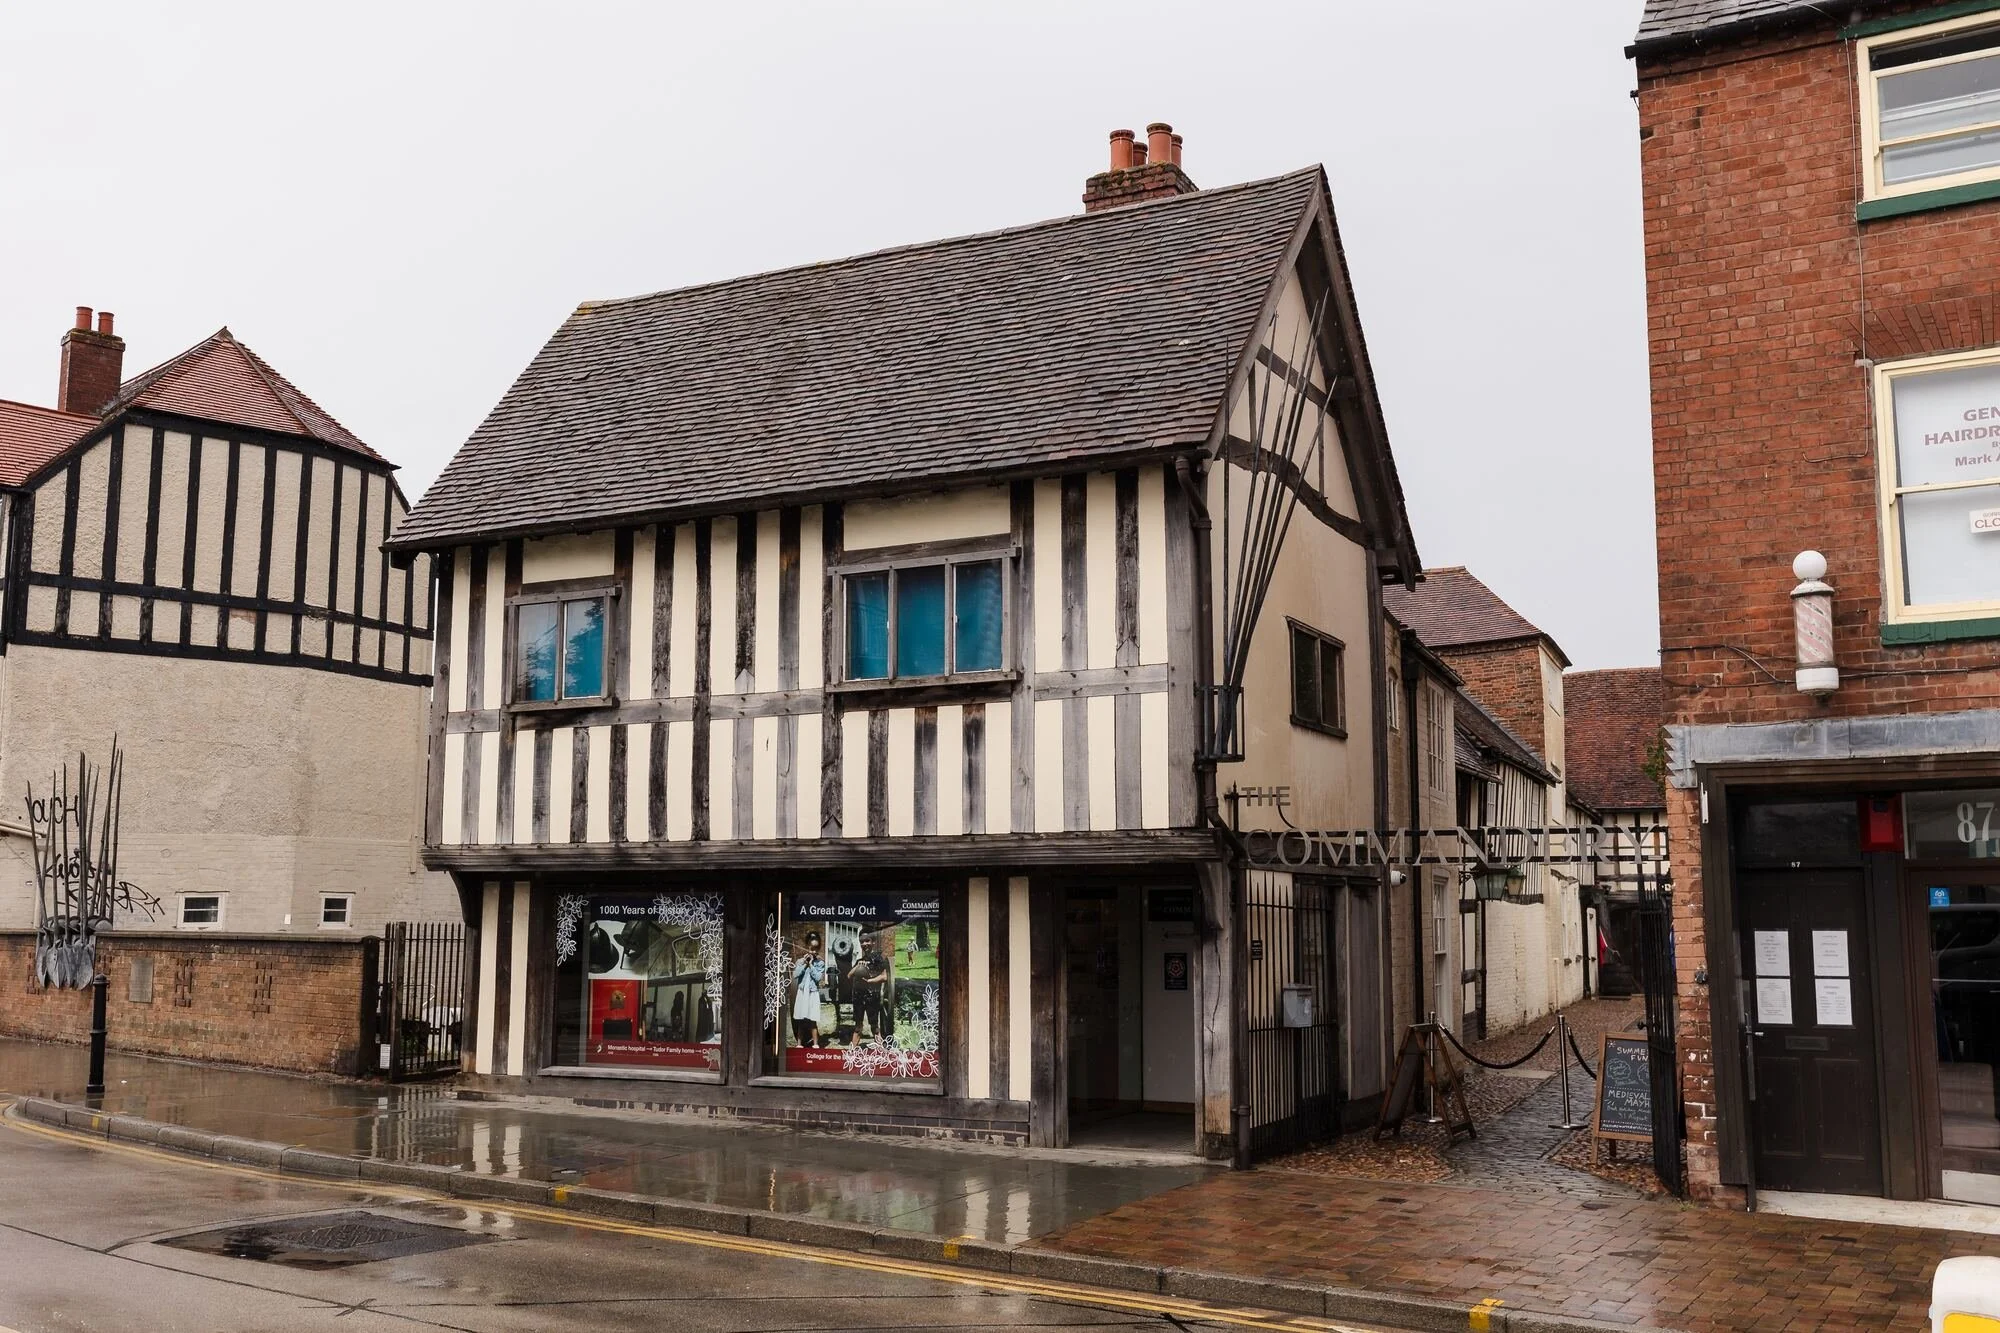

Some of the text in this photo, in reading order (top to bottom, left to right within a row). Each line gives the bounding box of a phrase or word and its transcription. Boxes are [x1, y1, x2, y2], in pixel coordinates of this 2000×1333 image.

[1963, 406, 2000, 421] GEN
[1924, 425, 2000, 446] HAIRDR
[1955, 454, 1992, 467] Mark
[1241, 786, 1291, 807] THE
[1957, 802, 1994, 843] 87
[1243, 822, 1660, 869] COMMANDERY
[599, 905, 620, 914] 1000
[621, 905, 645, 915] Years
[647, 905, 657, 915] of
[799, 905, 876, 917] A Great Day Out
[806, 1052, 825, 1060] College
